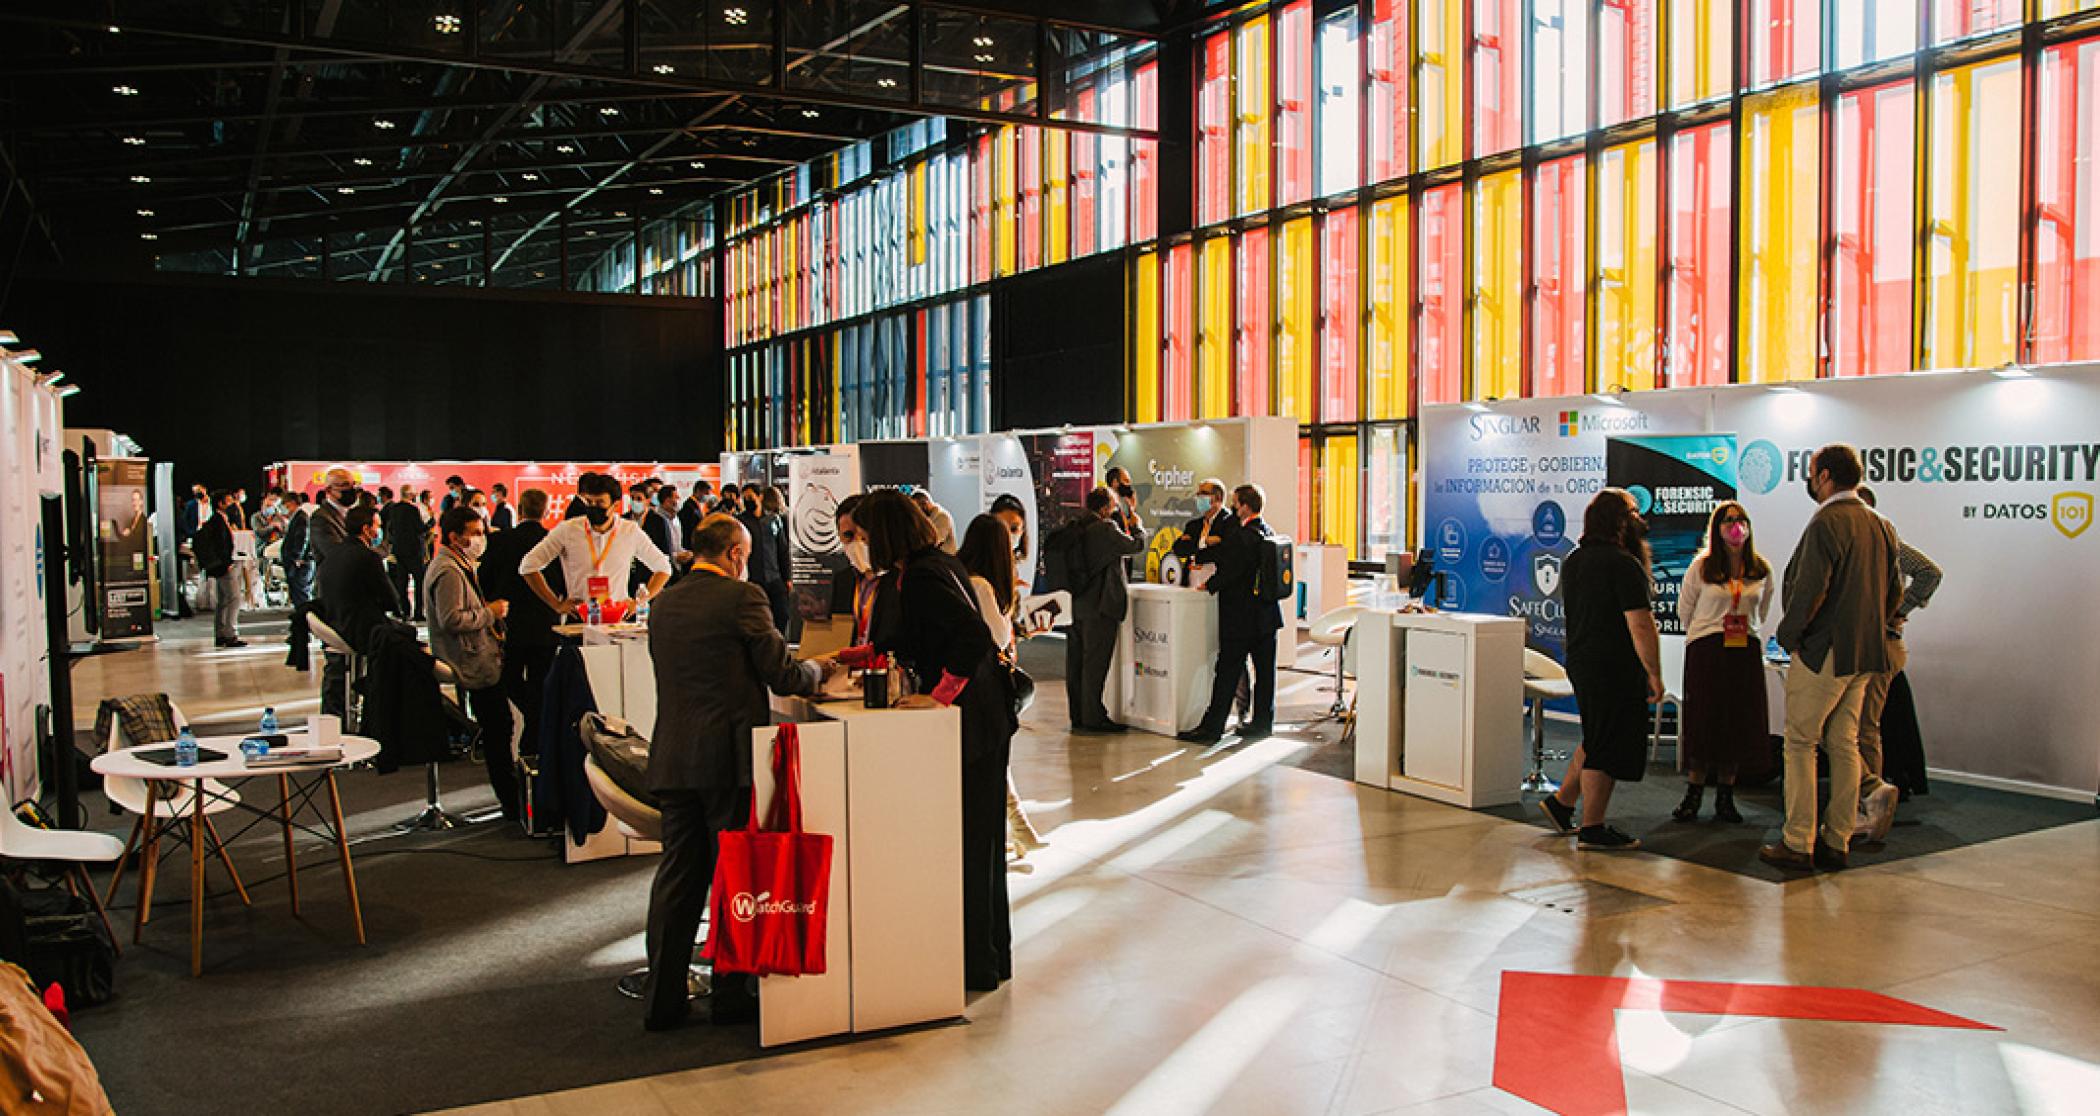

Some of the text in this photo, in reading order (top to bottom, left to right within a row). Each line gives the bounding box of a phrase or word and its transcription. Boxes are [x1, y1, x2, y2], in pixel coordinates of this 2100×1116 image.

[1469, 413, 1541, 441] SINGLAR
[1583, 411, 1648, 431] Microsoft
[1468, 459, 1528, 474] PROTEGE
[1445, 475, 1536, 494] INFORMACIÓN
[1655, 486, 1714, 500] FORENSIC
[1963, 504, 2085, 519] BY DATOS 101
[731, 892, 817, 922] WatchGuard
